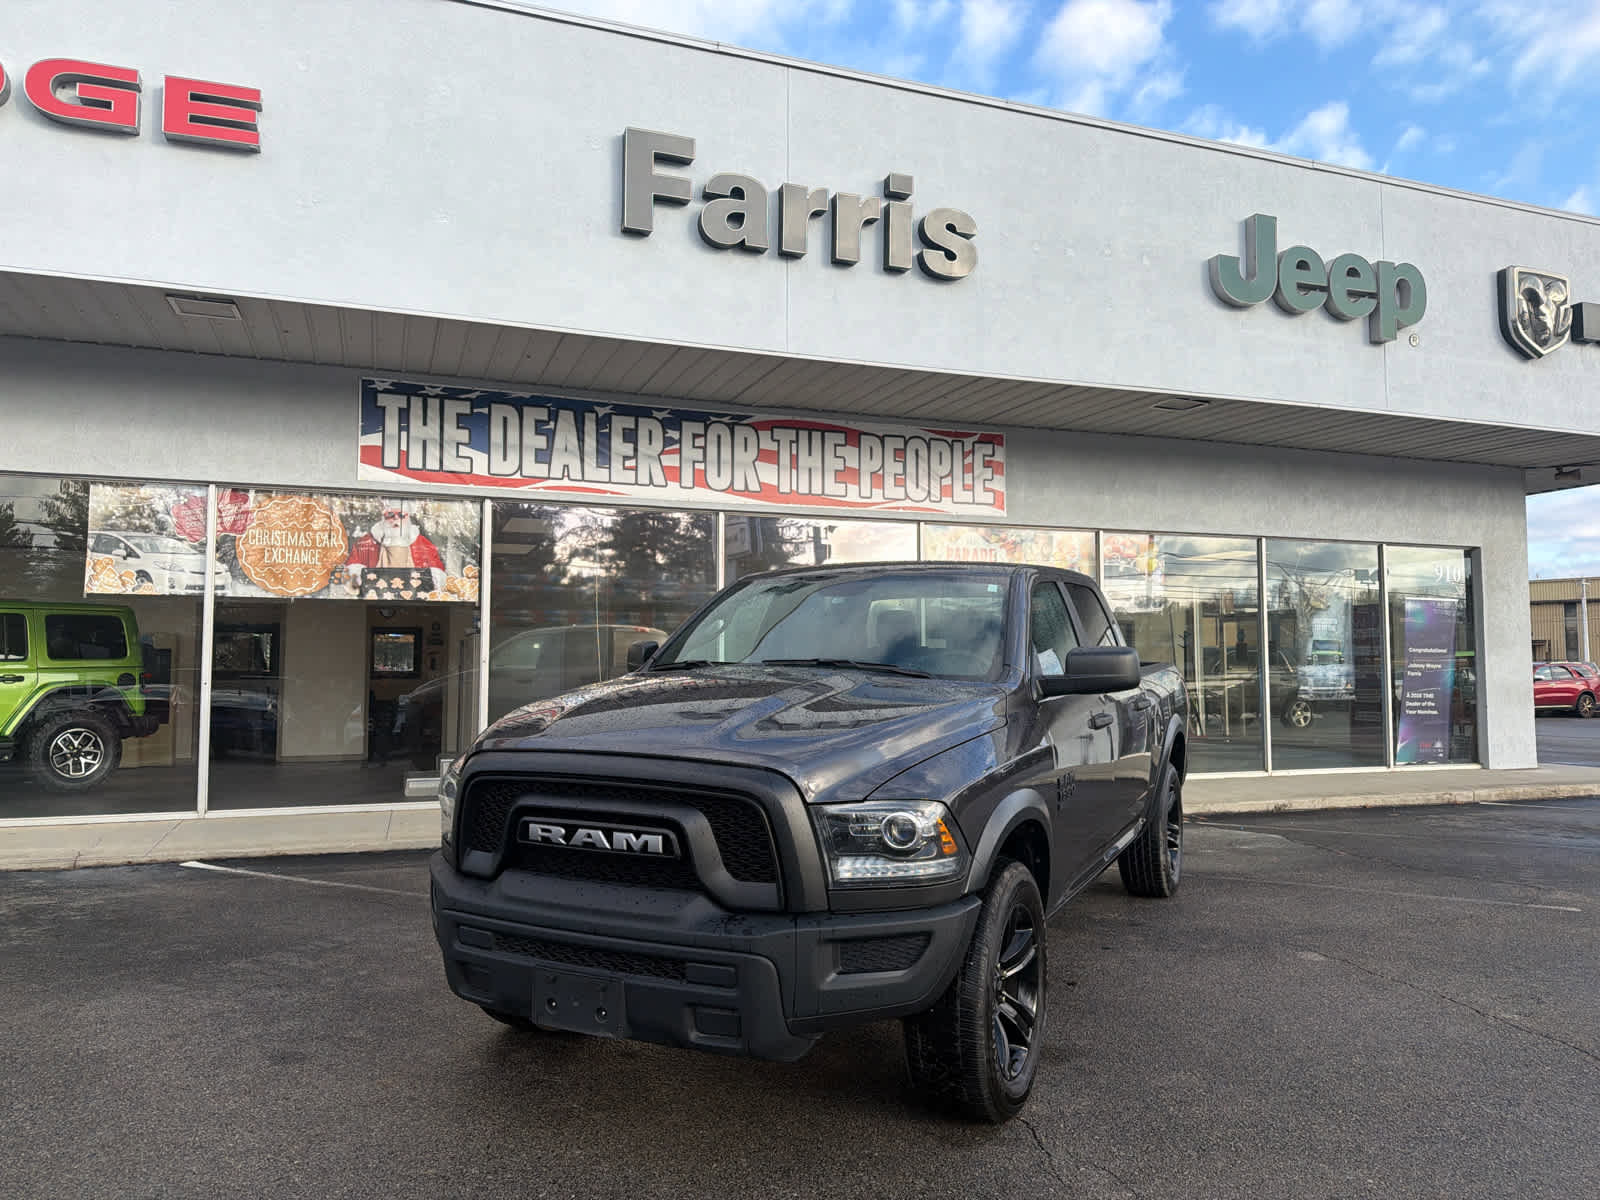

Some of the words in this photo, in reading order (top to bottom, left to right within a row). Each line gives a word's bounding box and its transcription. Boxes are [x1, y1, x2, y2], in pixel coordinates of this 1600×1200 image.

[0, 58, 262, 153] GE
[621, 127, 978, 280] Farris
[1208, 213, 1427, 344] Jeep
[376, 392, 473, 474] THE
[487, 402, 668, 487] DEALER
[680, 420, 761, 493] FOR
[771, 426, 848, 498] THE
[858, 432, 995, 506] PEOPLE
[248, 528, 313, 547] CHRISTMAS
[315, 531, 338, 548] CAR
[264, 547, 322, 565] EXCHANGE
[1433, 563, 1462, 585] 910
[528, 823, 663, 854] RAM
